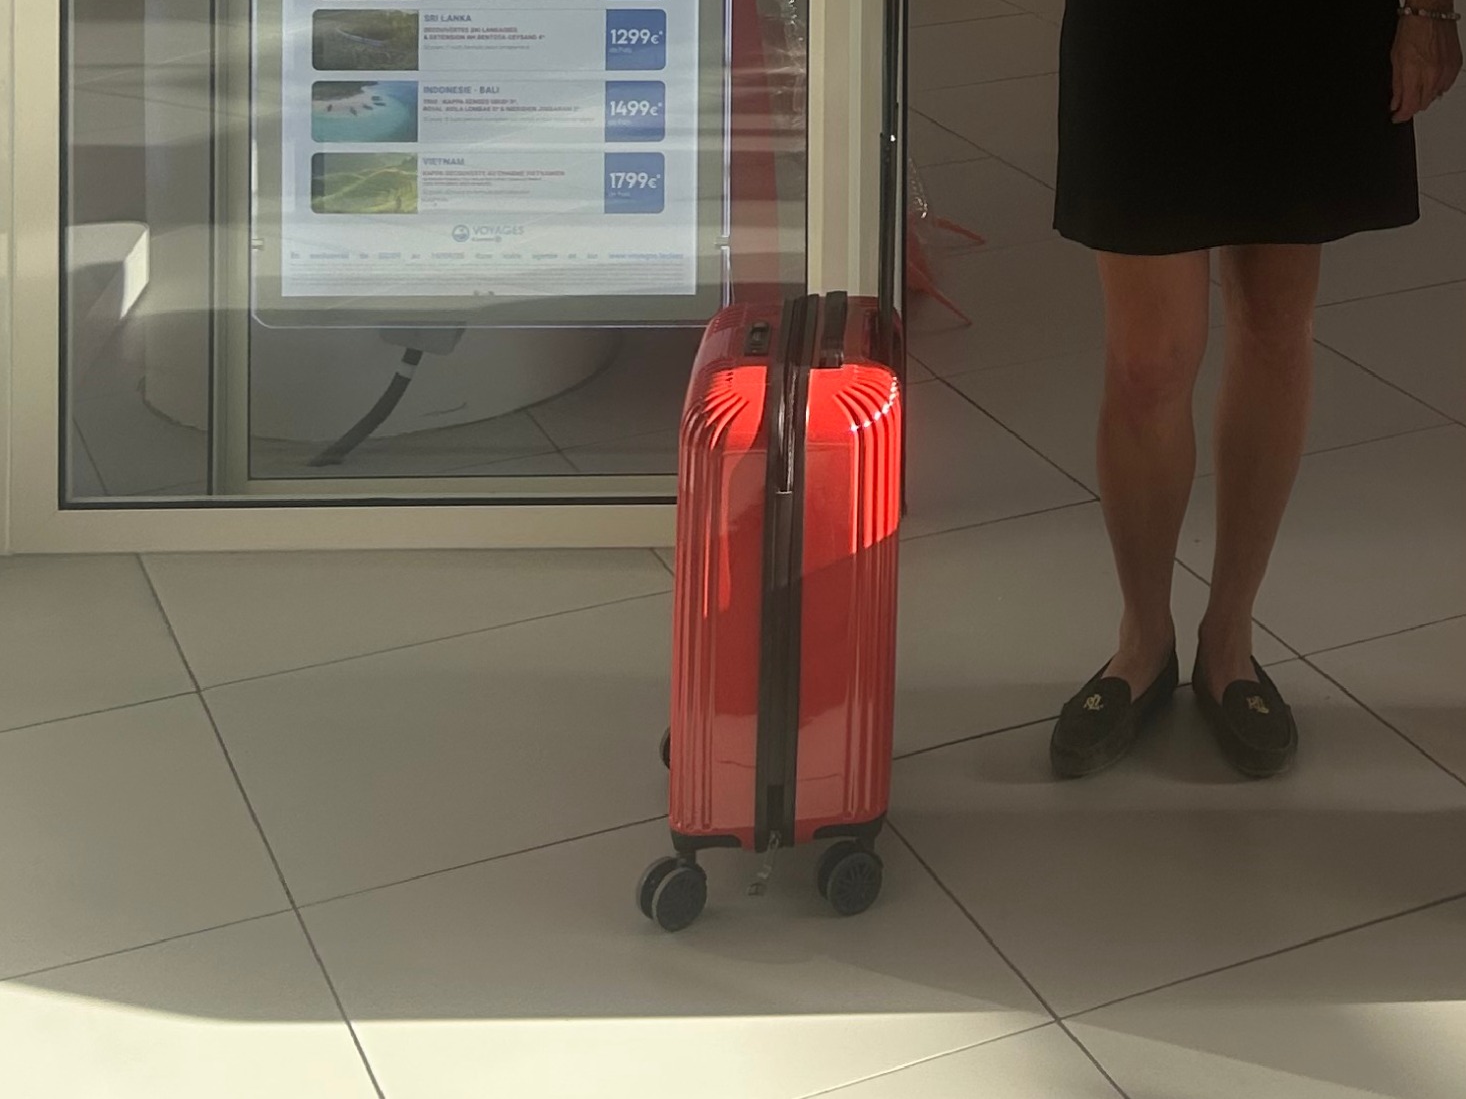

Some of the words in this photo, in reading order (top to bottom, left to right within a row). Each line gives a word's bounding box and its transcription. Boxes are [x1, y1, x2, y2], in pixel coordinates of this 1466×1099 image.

[424, 14, 438, 22] SRI
[441, 14, 472, 22] LANKA
[480, 86, 500, 94] BALI
[472, 225, 525, 235] VOYAGES
